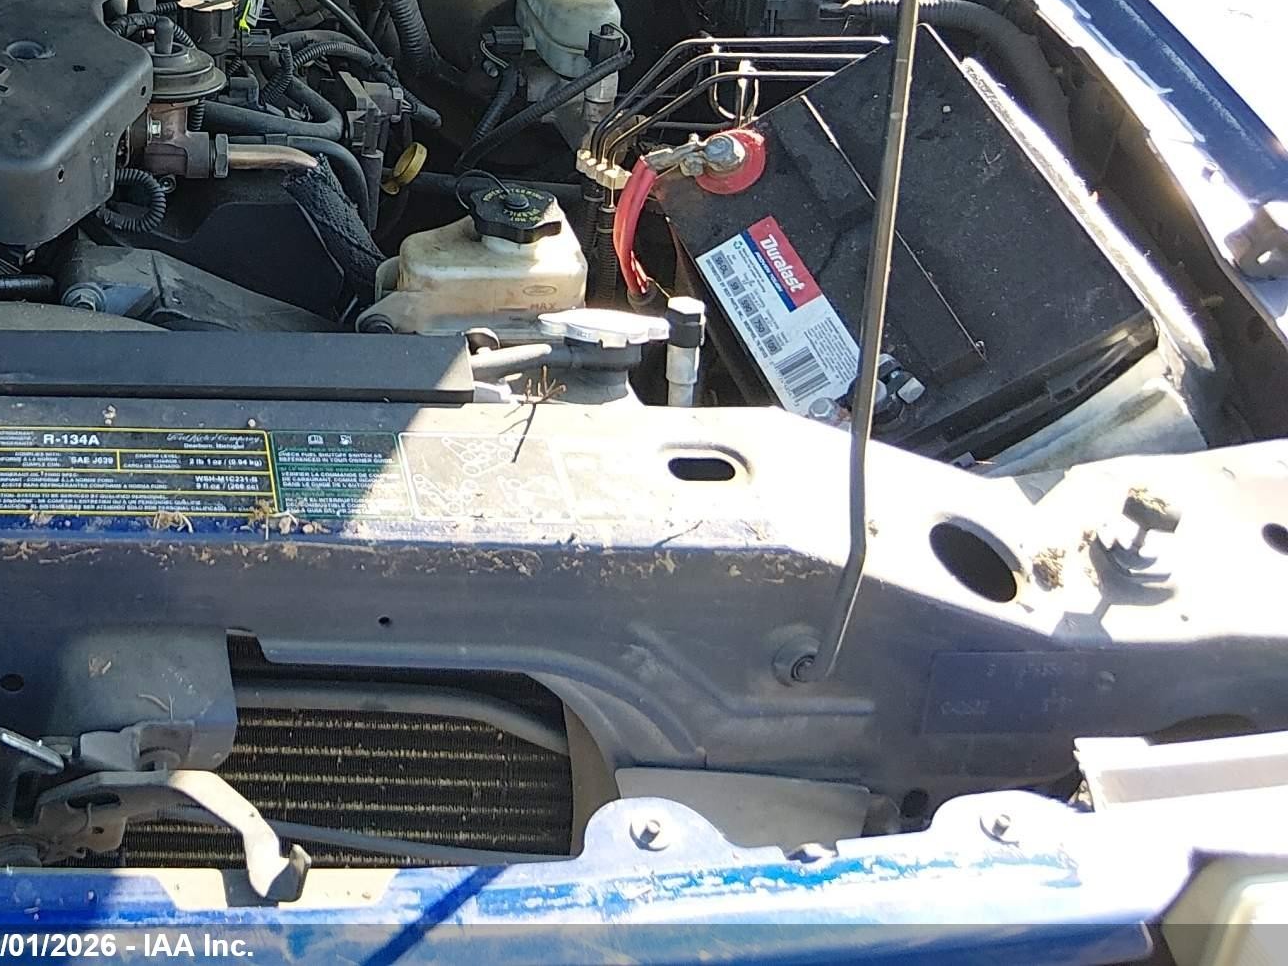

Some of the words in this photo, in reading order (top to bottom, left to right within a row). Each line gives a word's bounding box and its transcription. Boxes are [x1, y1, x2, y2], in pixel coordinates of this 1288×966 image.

[758, 232, 805, 295] Duralast
[529, 302, 557, 311] MAX
[753, 318, 766, 333] 750
[765, 338, 777, 352] 100
[43, 433, 100, 446] R-134A
[71, 456, 90, 464] SAE
[92, 456, 114, 464] J639
[196, 458, 204, 466] lb
